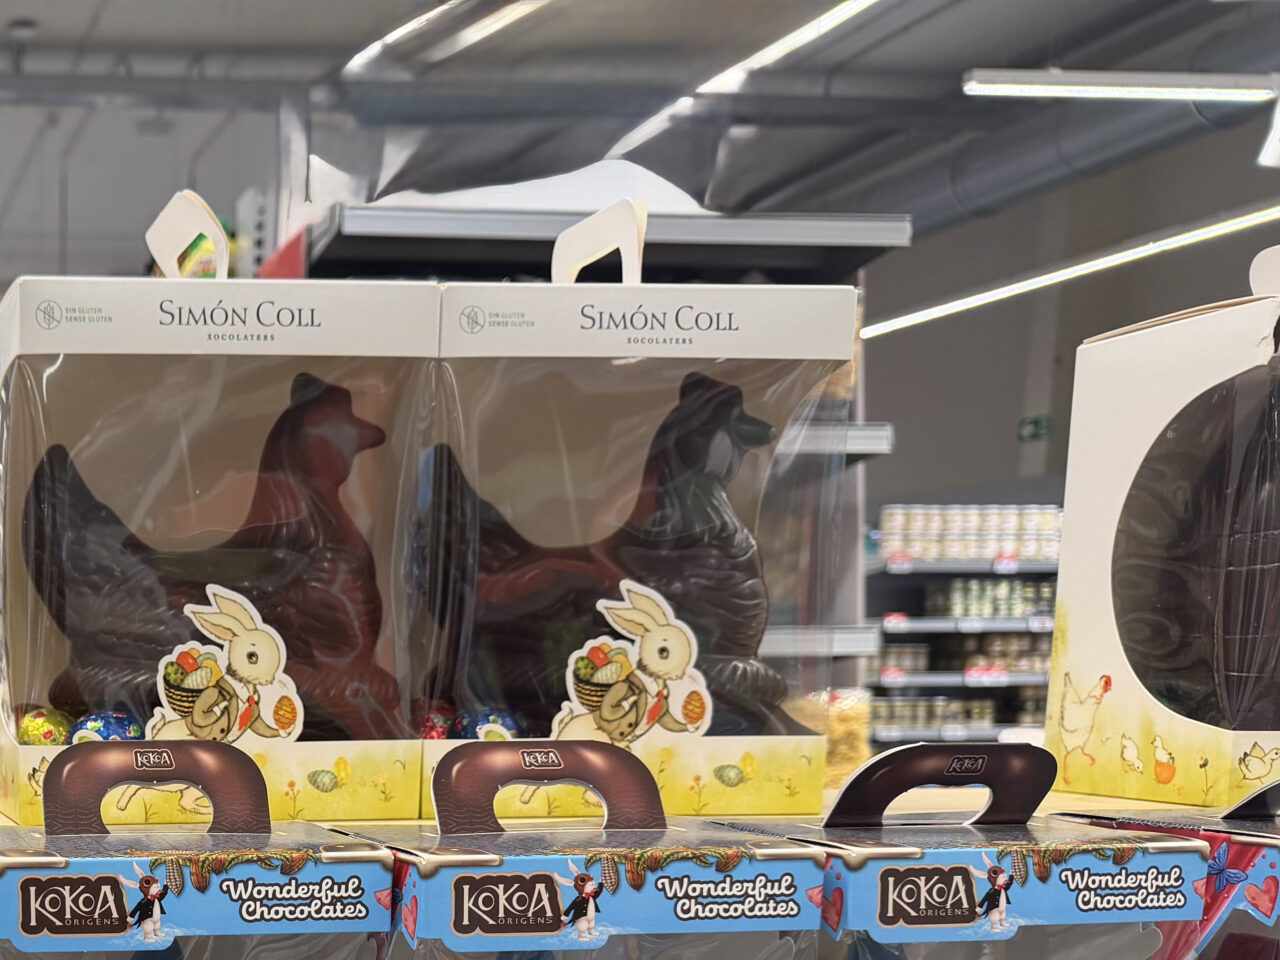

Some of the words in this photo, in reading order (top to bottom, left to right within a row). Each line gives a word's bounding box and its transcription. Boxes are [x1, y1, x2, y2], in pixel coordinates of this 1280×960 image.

[159, 299, 248, 327] SIMÓN
[256, 301, 322, 328] COLL
[580, 304, 668, 331] SIMÓN
[675, 306, 740, 331] COLL
[221, 877, 362, 902] Wonderful
[658, 875, 795, 900] Wonderful
[1061, 868, 1183, 892] Wonderful
[241, 899, 368, 922] Chocolates
[676, 897, 799, 920] Chocolates
[1077, 889, 1185, 911] Chocolates
[64, 918, 118, 926] ORIGENS
[498, 916, 553, 925] ORIGENS
[920, 908, 969, 916] ORIGENS
